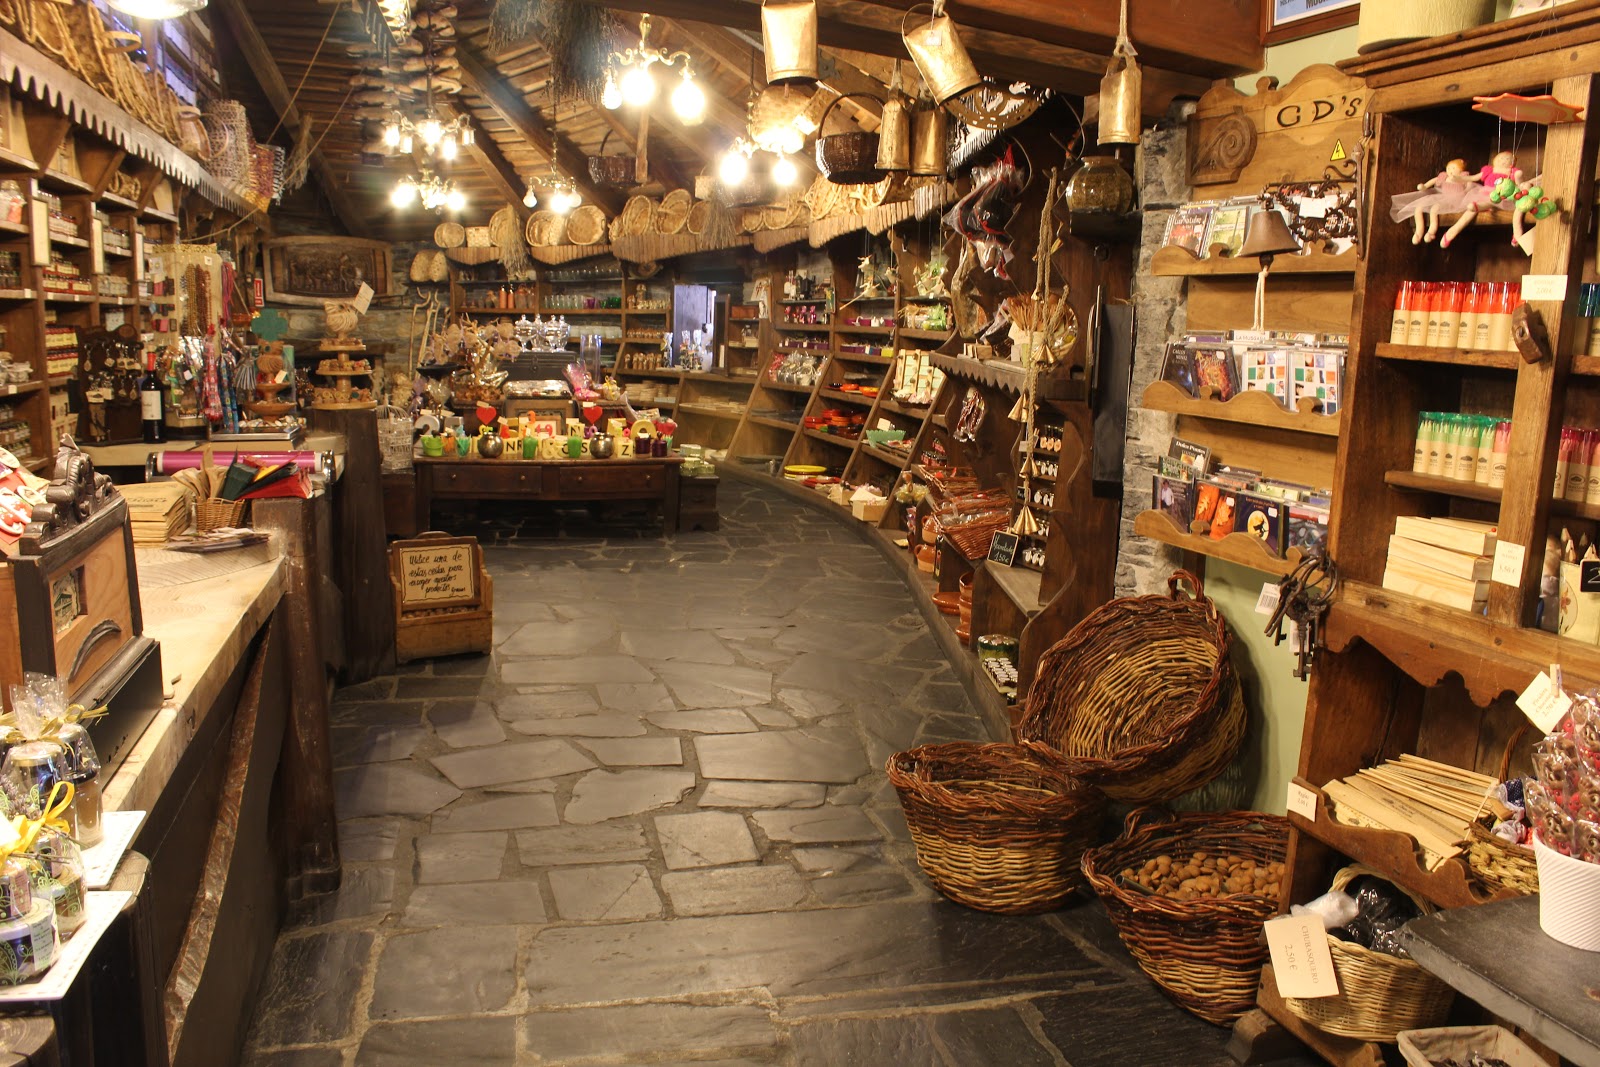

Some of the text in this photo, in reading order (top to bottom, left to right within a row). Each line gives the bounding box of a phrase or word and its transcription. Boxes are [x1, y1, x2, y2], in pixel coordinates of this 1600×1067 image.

[621, 445, 630, 456] Z
[453, 550, 462, 561] de
[1284, 944, 1296, 963] 2,50
[1301, 925, 1319, 984] CHUBASQUERO
